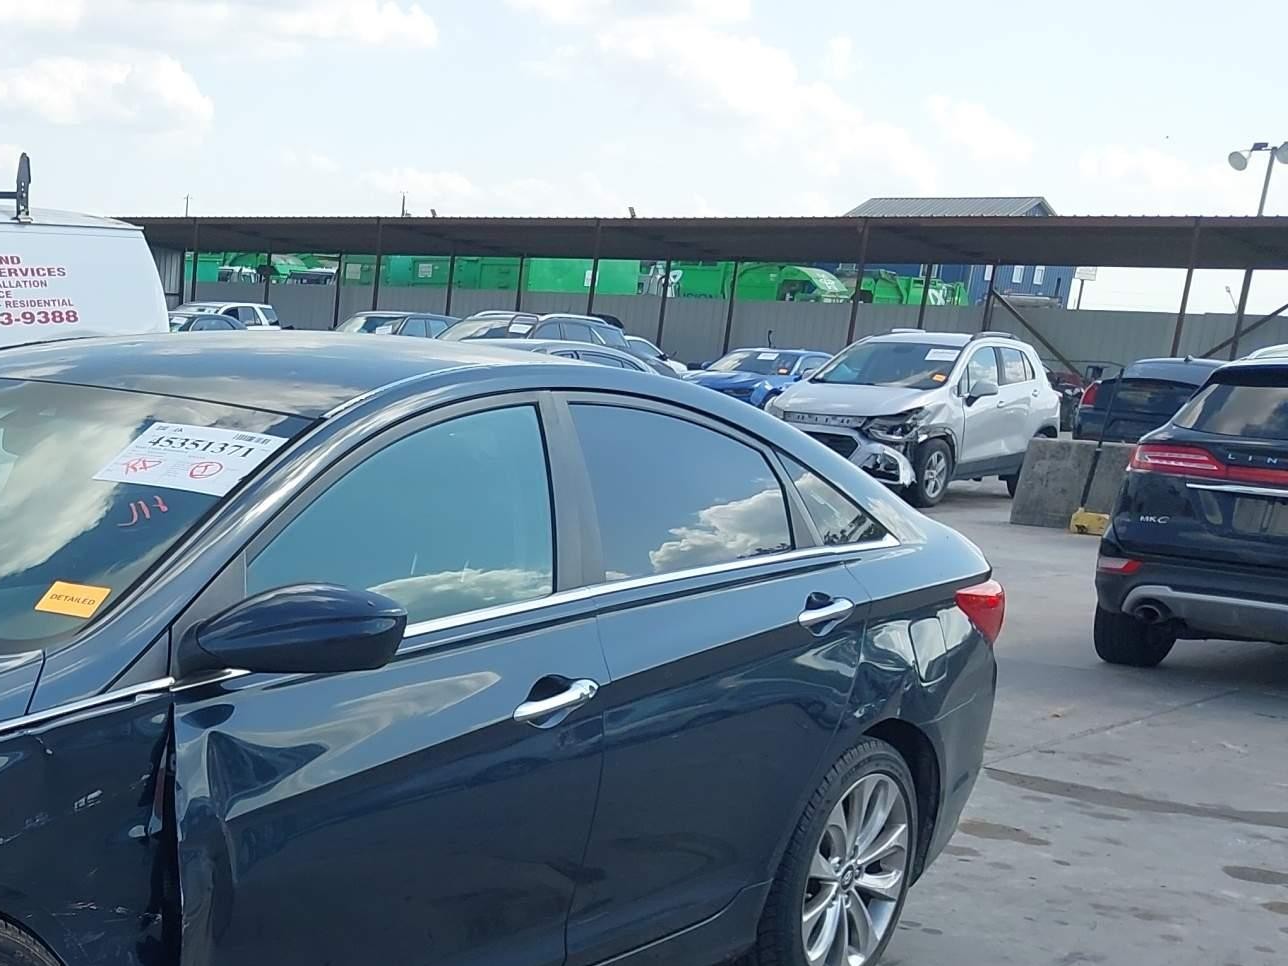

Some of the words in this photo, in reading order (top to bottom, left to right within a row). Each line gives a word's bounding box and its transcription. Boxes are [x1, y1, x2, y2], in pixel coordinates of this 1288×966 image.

[5, 299, 74, 309] RESIDENTIAL
[147, 435, 255, 458] 45351371
[1140, 515, 1170, 524] MKC
[49, 593, 96, 606] DETAILED
